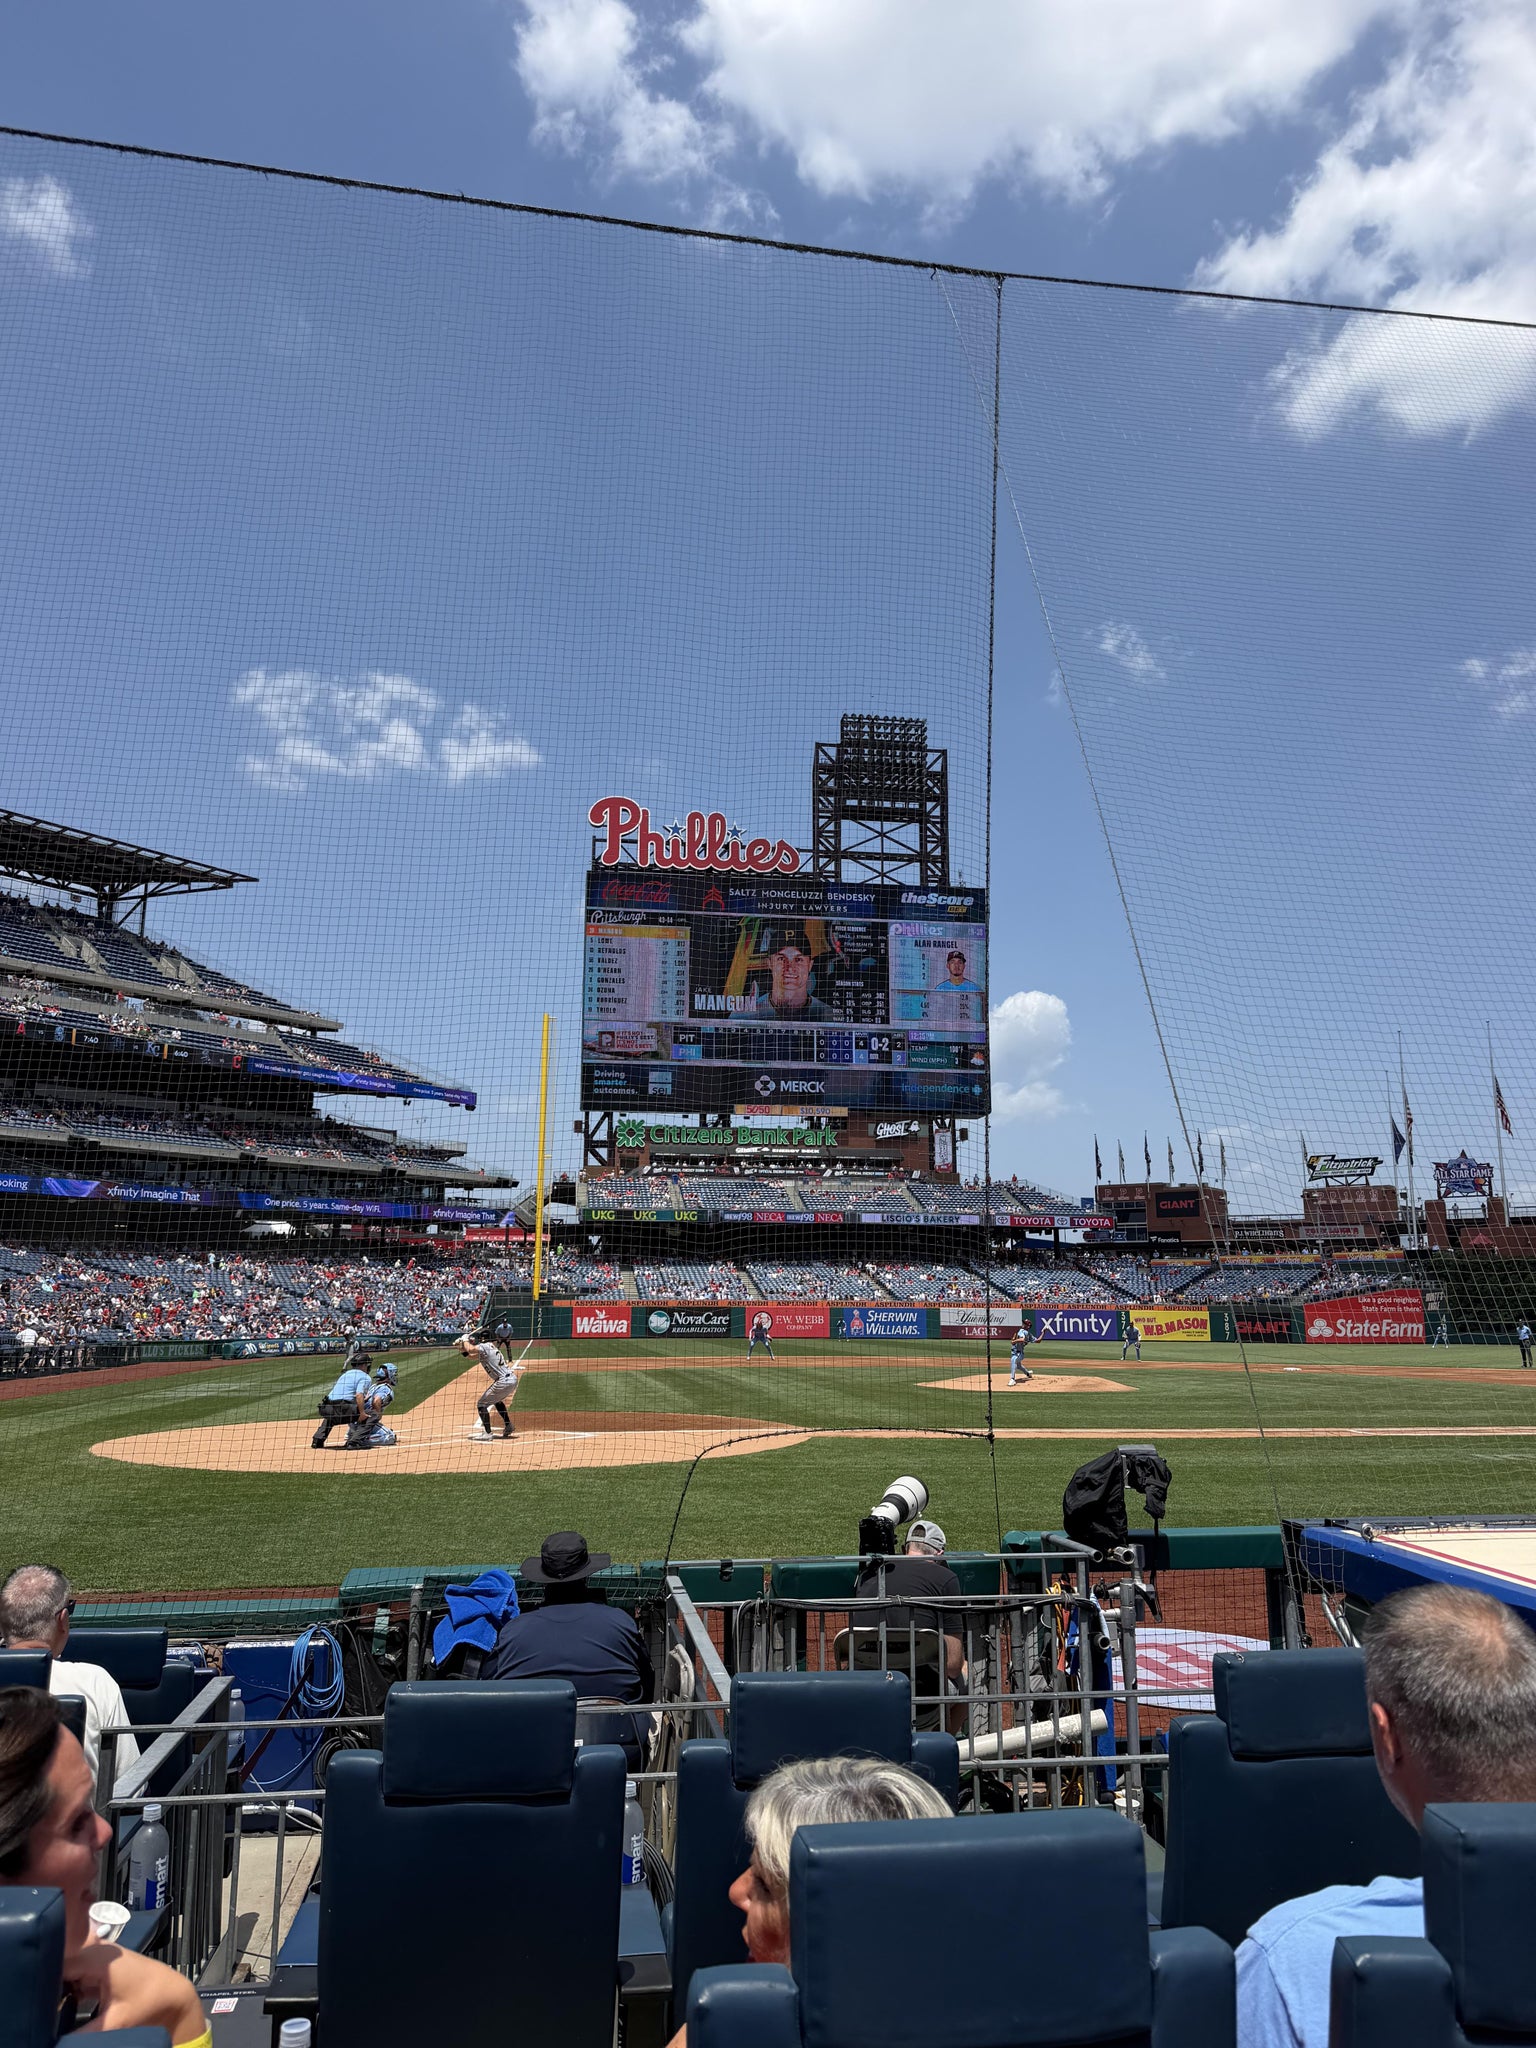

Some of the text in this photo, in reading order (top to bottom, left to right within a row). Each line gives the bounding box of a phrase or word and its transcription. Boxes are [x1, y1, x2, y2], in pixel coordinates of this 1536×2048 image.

[588, 796, 800, 873] Phillies
[729, 888, 876, 902] SALTZ MONGELUZZI BENDESKY
[901, 892, 974, 906] theScore
[758, 902, 848, 913] INJURY LAWYERS
[590, 911, 647, 925] Pittsburgh
[889, 923, 944, 936] Phillies
[914, 940, 958, 949] ALAN RANGEL
[694, 994, 757, 1012] MANGUM
[16, 1023, 26, 1035] A
[83, 1035, 99, 1044] 7:40
[679, 1034, 695, 1042] PIT
[870, 1037, 890, 1051] 0-2
[174, 1050, 189, 1058] 6:40
[679, 1047, 695, 1056] PHI
[594, 1070, 626, 1079] Driving
[594, 1078, 627, 1086] smarter
[780, 1080, 825, 1094] MERCK
[902, 1082, 970, 1094] independence
[593, 1087, 639, 1095] outcomes.
[800, 1107, 831, 1115] $10,590
[650, 1124, 838, 1146] Citizens Bank Park
[876, 1121, 910, 1139] GHOST
[1314, 1156, 1374, 1171] Fitzpatrick
[1435, 1167, 1493, 1179] ALL STAR GAME
[107, 1186, 200, 1202] xfinity Imagine That
[264, 1198, 280, 1207] One
[281, 1199, 302, 1210] price.
[309, 1202, 329, 1212] years.
[330, 1202, 365, 1213] Same-day
[1159, 1200, 1195, 1209] GIANT
[433, 1208, 496, 1221] xfinity Imagine That
[591, 1210, 615, 1220] UKG
[633, 1211, 657, 1221] UKG
[675, 1211, 698, 1221] UKG
[756, 1212, 783, 1222] NECA
[817, 1213, 844, 1223] NECA
[923, 1214, 960, 1224] BAKERY
[1013, 1216, 1051, 1226] TOYOTA
[1072, 1217, 1111, 1227] TOYOTA
[1377, 1297, 1392, 1305] good
[1393, 1297, 1421, 1305] neighbor,
[671, 1312, 730, 1325] NovaCare
[795, 1315, 825, 1324] WEBB
[867, 1309, 918, 1323] SHERWIN
[576, 1316, 629, 1333] Wawa
[1041, 1311, 1112, 1336] xfinity
[1236, 1321, 1290, 1334] GIANT
[168, 1345, 204, 1357] PICKLES
[245, 1343, 258, 1355] 10
[631, 1832, 642, 1884] smart
[156, 1855, 168, 1909] smart
